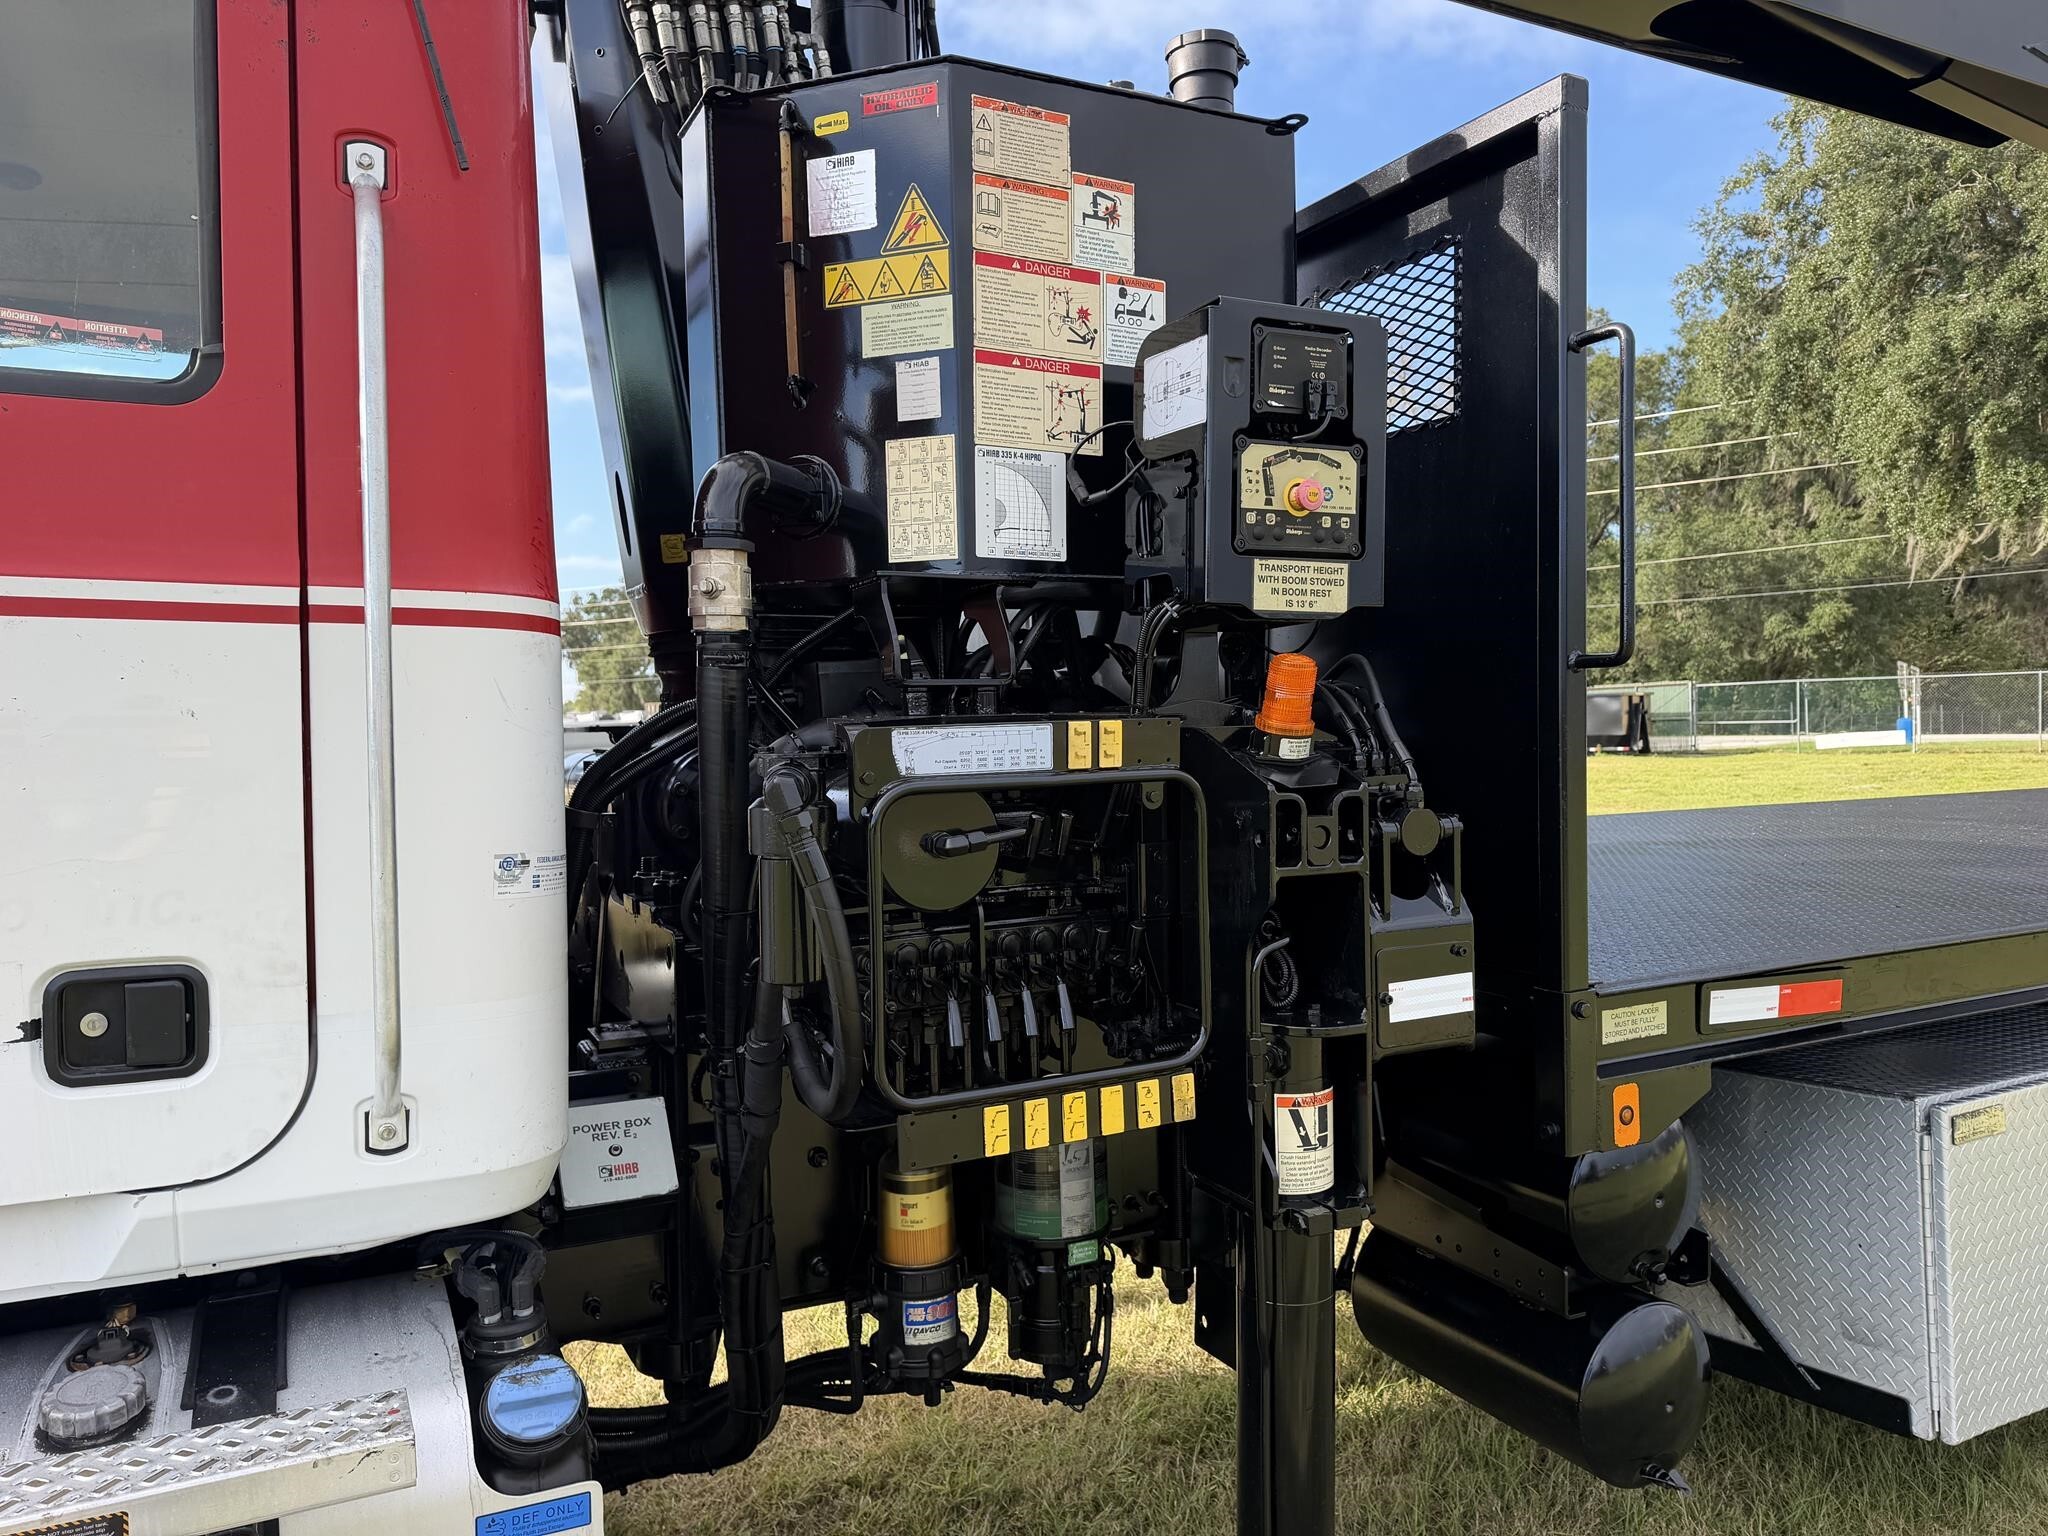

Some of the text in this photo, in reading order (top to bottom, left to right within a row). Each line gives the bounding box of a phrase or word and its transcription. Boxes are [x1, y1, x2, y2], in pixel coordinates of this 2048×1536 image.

[866, 86, 933, 104] HYDRAULIC
[874, 96, 925, 112] OIL ONLY
[1011, 106, 1043, 119] WARNING
[833, 118, 848, 126] Max.
[837, 156, 855, 168] HIAB
[1011, 181, 1044, 195] WARNING
[1093, 180, 1124, 192] WARNING
[1025, 262, 1070, 278] DANGER
[1125, 278, 1155, 289] WARNING
[913, 360, 930, 368] HIAB
[1025, 359, 1070, 373] DANGER
[986, 449, 1042, 461] HIAB 335 K-4 HIPRO
[1259, 563, 1344, 575] TRANSPORT HEIGHT
[1258, 575, 1345, 587] WITH BOOM STOWED
[1282, 588, 1307, 596] BOOM
[1310, 589, 1332, 597] REST
[1638, 1007, 1659, 1015] LADDER
[1615, 1020, 1629, 1028] MUST
[1640, 1016, 1656, 1024] FULLY
[1605, 1023, 1665, 1039] STORED AND LATCHED
[573, 1117, 651, 1135] POWER BOX
[592, 1131, 620, 1142] REV.
[613, 1161, 639, 1176] HIAB
[913, 1325, 942, 1335] DAVCO
[512, 1500, 584, 1526] DEF ONLY
